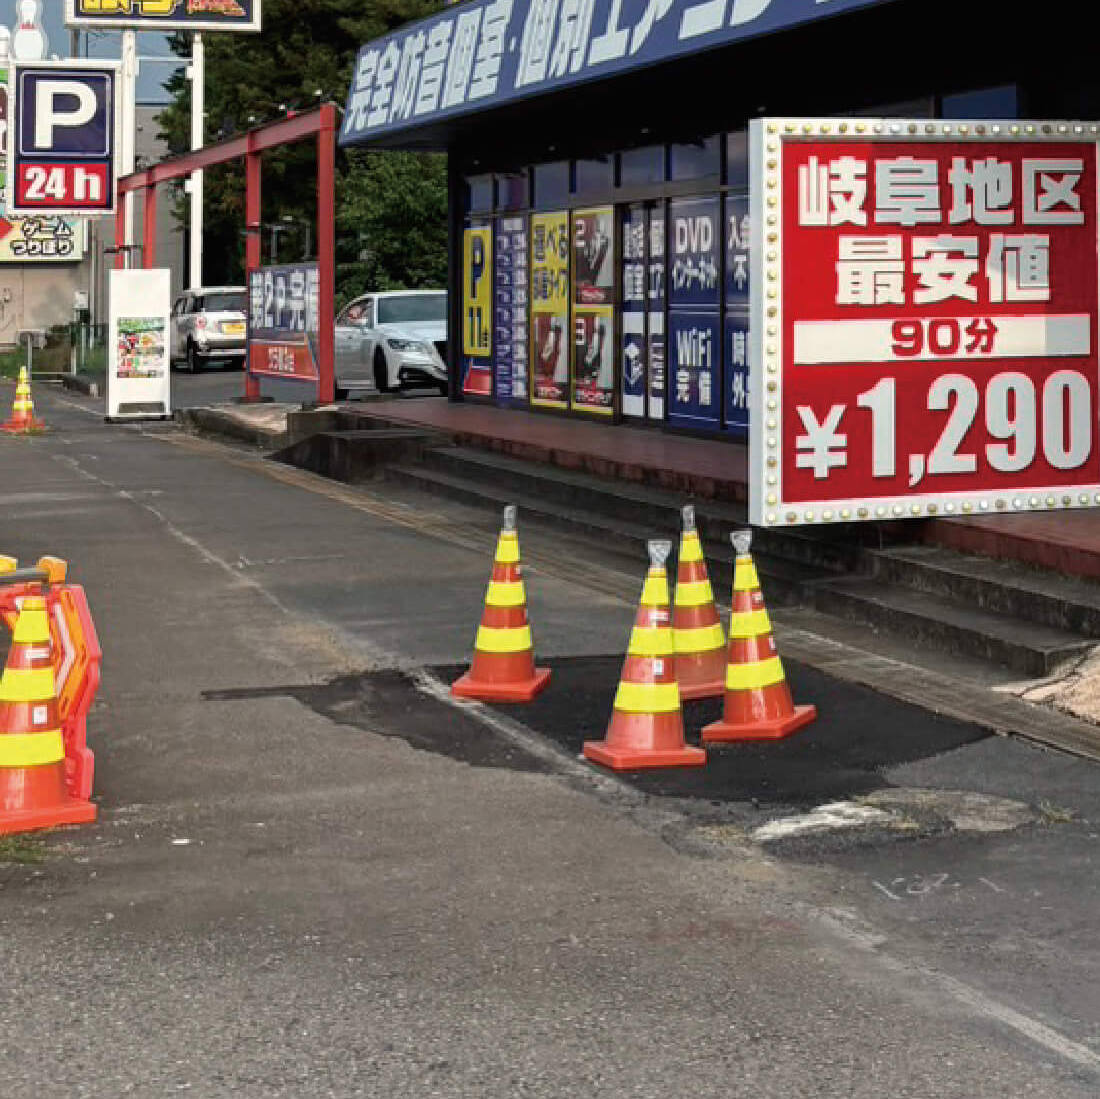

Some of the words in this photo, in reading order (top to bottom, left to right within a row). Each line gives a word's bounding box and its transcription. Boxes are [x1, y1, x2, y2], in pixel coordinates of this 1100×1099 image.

[34, 79, 98, 149] P
[798, 155, 1085, 227] 岐阜地区
[675, 216, 713, 255] DVD
[835, 233, 1051, 305] 最安値
[676, 327, 712, 367] WiFi
[891, 318, 998, 358] 90分
